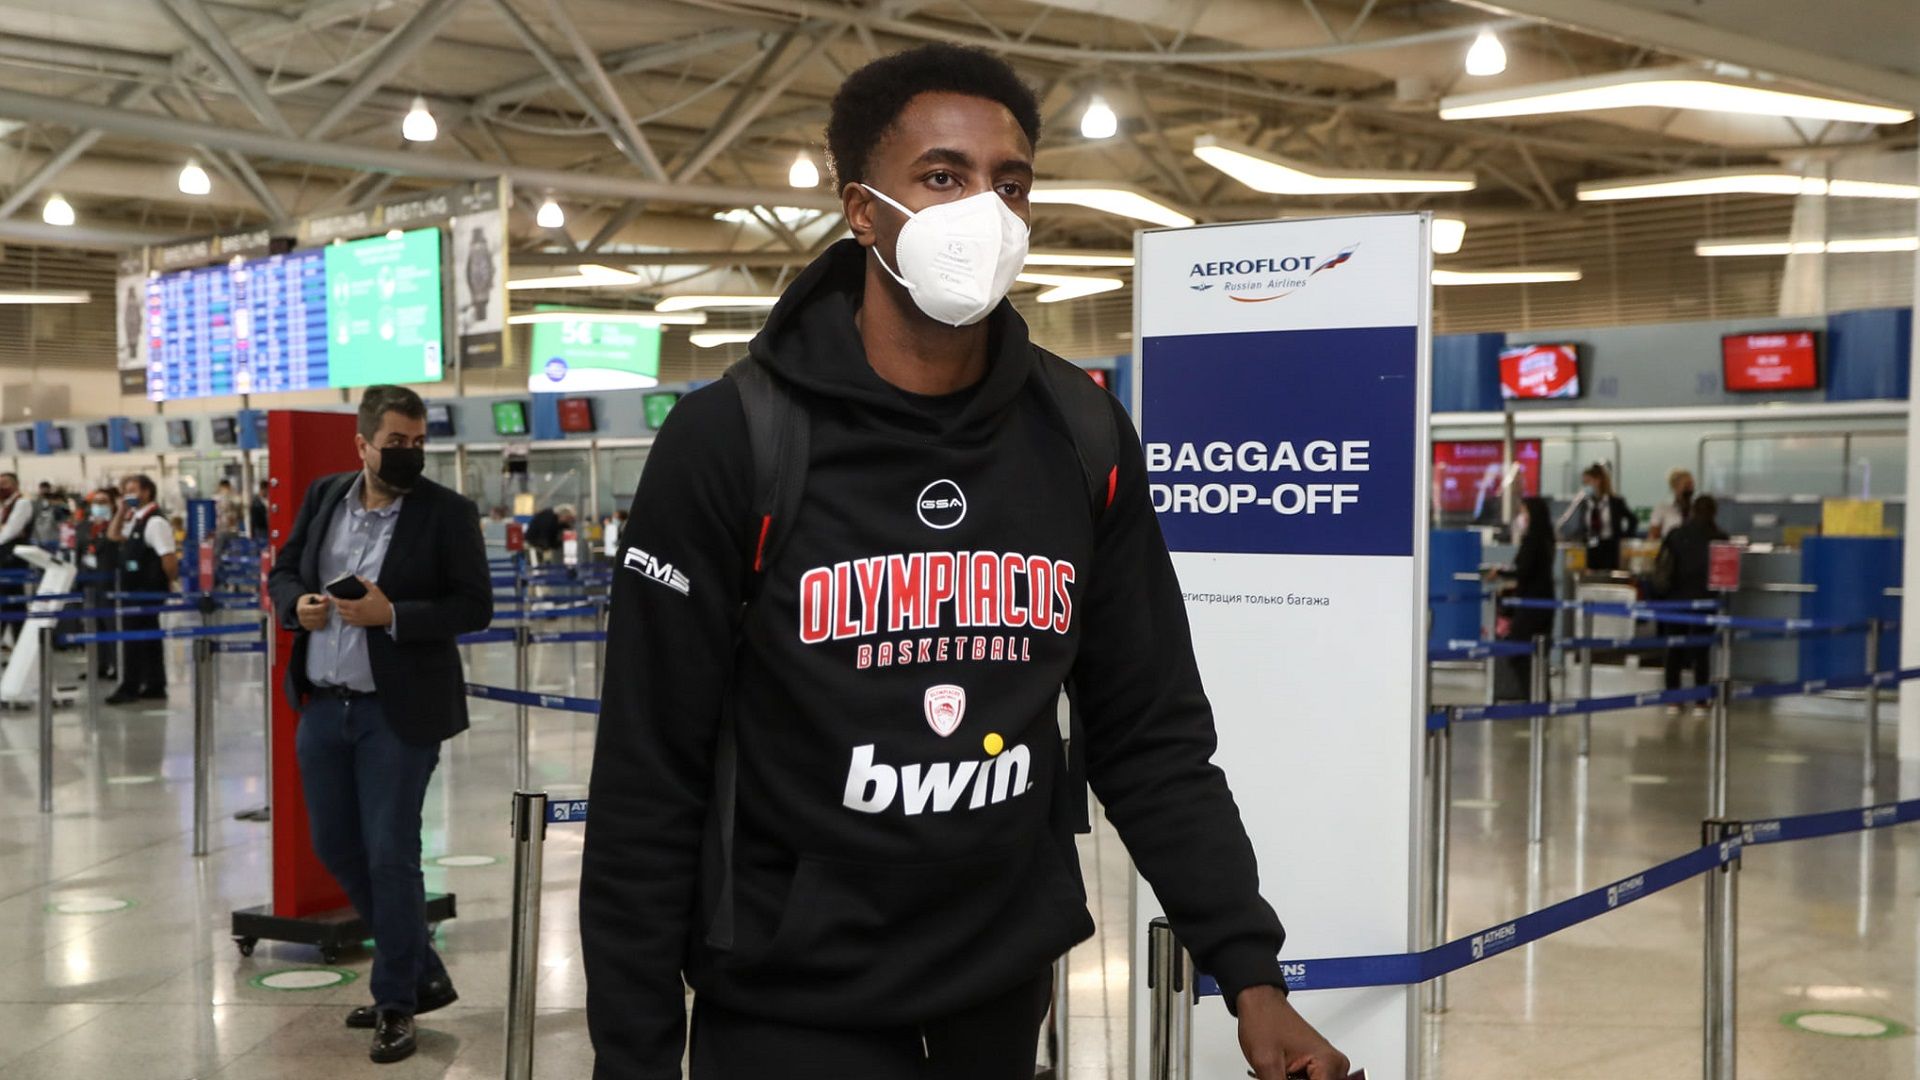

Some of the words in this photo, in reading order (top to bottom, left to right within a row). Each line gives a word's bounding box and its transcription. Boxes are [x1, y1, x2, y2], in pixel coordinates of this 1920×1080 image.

[1190, 256, 1316, 278] AEROFLOT
[1224, 281, 1262, 291] Russian
[1267, 279, 1307, 289] Airlines
[1146, 440, 1370, 472] BAGGAGE
[1149, 483, 1360, 515] DROP-OFF
[800, 551, 1075, 643] OLYMPIACOS
[1245, 594, 1284, 605] только
[1287, 593, 1330, 606] багажа
[857, 636, 1030, 669] BASKETBALL
[842, 732, 1032, 816] bwin
[1484, 923, 1516, 944] ATHENS
